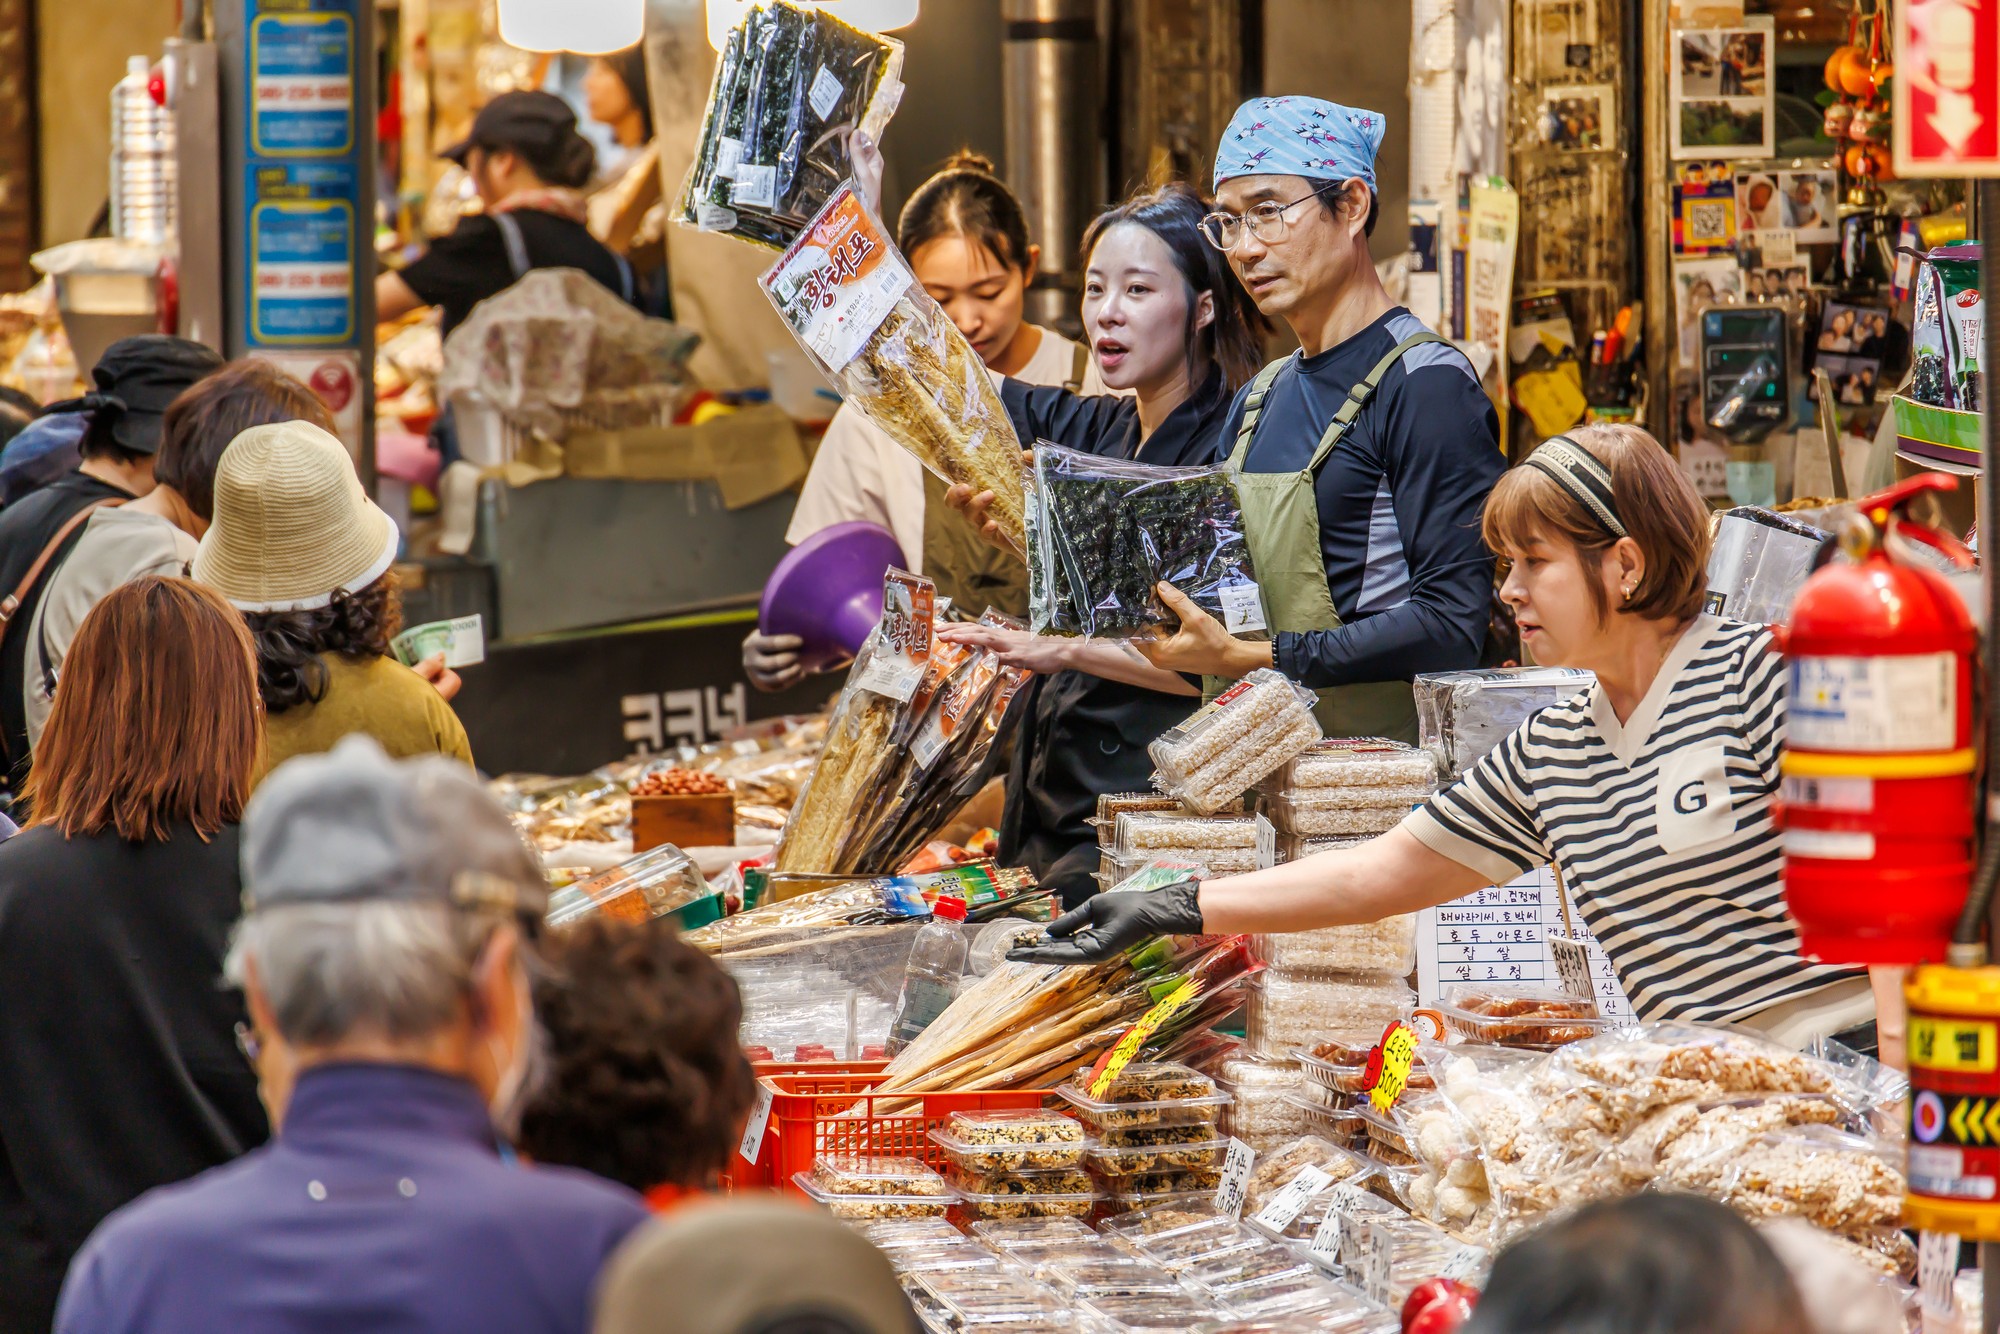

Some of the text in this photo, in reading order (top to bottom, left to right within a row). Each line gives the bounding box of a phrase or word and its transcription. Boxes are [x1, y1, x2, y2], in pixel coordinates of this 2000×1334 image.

[803, 229, 875, 311] 황태포
[891, 612, 927, 655] 황태포
[1673, 780, 1708, 815] G
